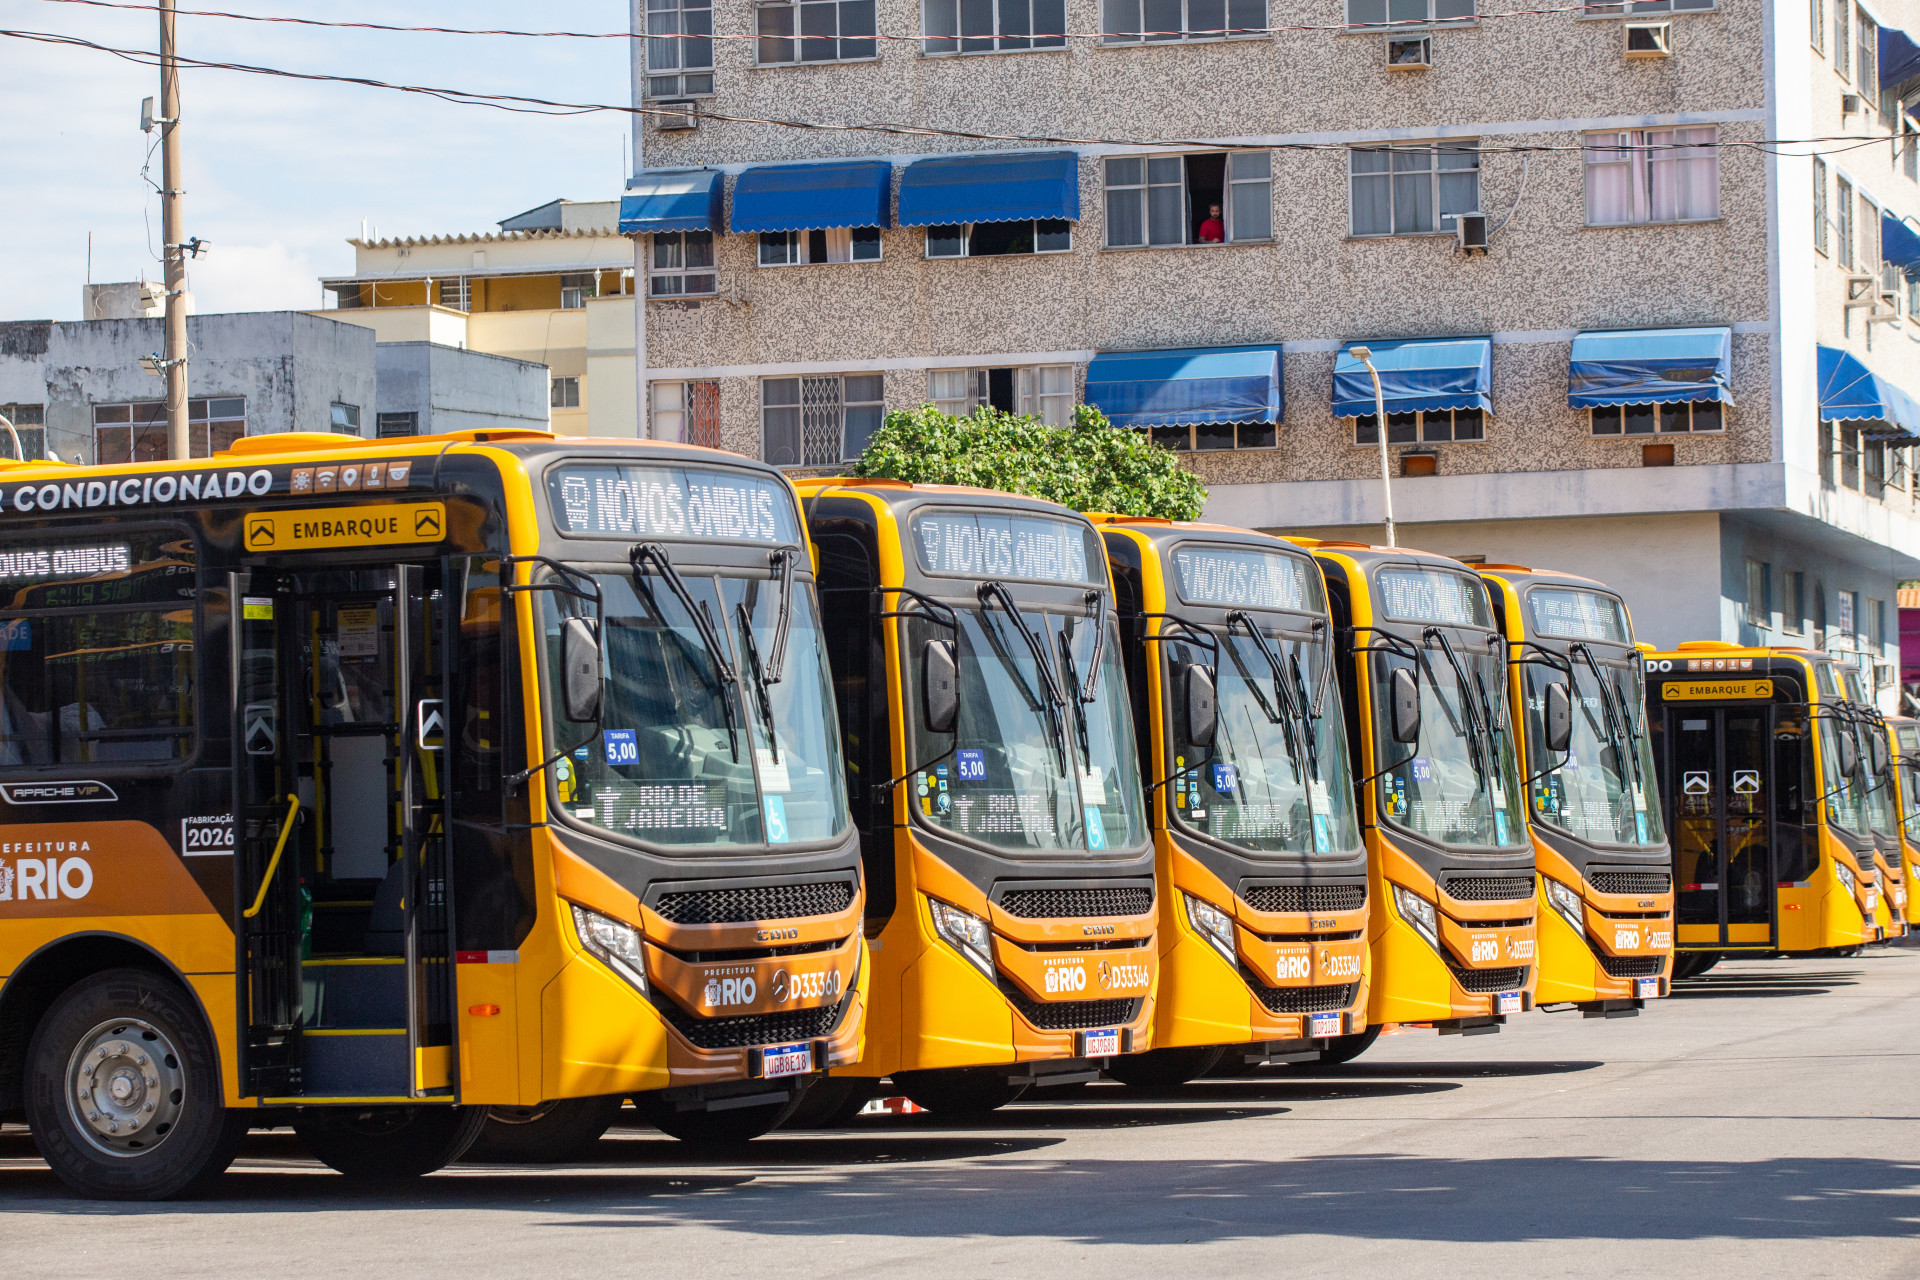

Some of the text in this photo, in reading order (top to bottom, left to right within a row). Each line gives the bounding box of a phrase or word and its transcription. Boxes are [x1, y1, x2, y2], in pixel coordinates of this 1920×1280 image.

[13, 469, 273, 512] CONDICIONADO
[366, 479, 381, 487] USB
[595, 478, 685, 534] NOVOS
[293, 517, 398, 539] EMBARQUE
[944, 523, 1013, 576] NOVOS
[1192, 556, 1248, 602] NOVOS
[1689, 685, 1747, 695] EMBARQUE
[610, 732, 630, 740] TARIFA
[607, 742, 637, 762] 5,00
[960, 760, 985, 779] 5,00
[1414, 766, 1430, 780] 5,00
[13, 786, 100, 797] APACHE VIP
[1216, 774, 1236, 790] 5,00
[639, 784, 707, 806] RIO DE
[988, 794, 1014, 813] RIO
[624, 807, 724, 829] JANEIRO
[976, 815, 1054, 833] JANEIRO
[188, 827, 235, 847] 2026
[16, 856, 94, 900] RIO
[1623, 930, 1640, 949] RIO
[1276, 947, 1310, 955] PREFEITURA
[1481, 940, 1499, 961] RIO
[704, 966, 756, 976] PREFEITURA
[1043, 957, 1085, 966] PREFEITURA
[1288, 955, 1311, 978] RIO
[1330, 955, 1361, 977] D33340
[790, 969, 842, 1000] D33360
[1058, 965, 1087, 992] RIO
[1112, 965, 1149, 989] D33346
[722, 976, 757, 1006] RIO
[768, 1053, 807, 1075] UGB8E18
